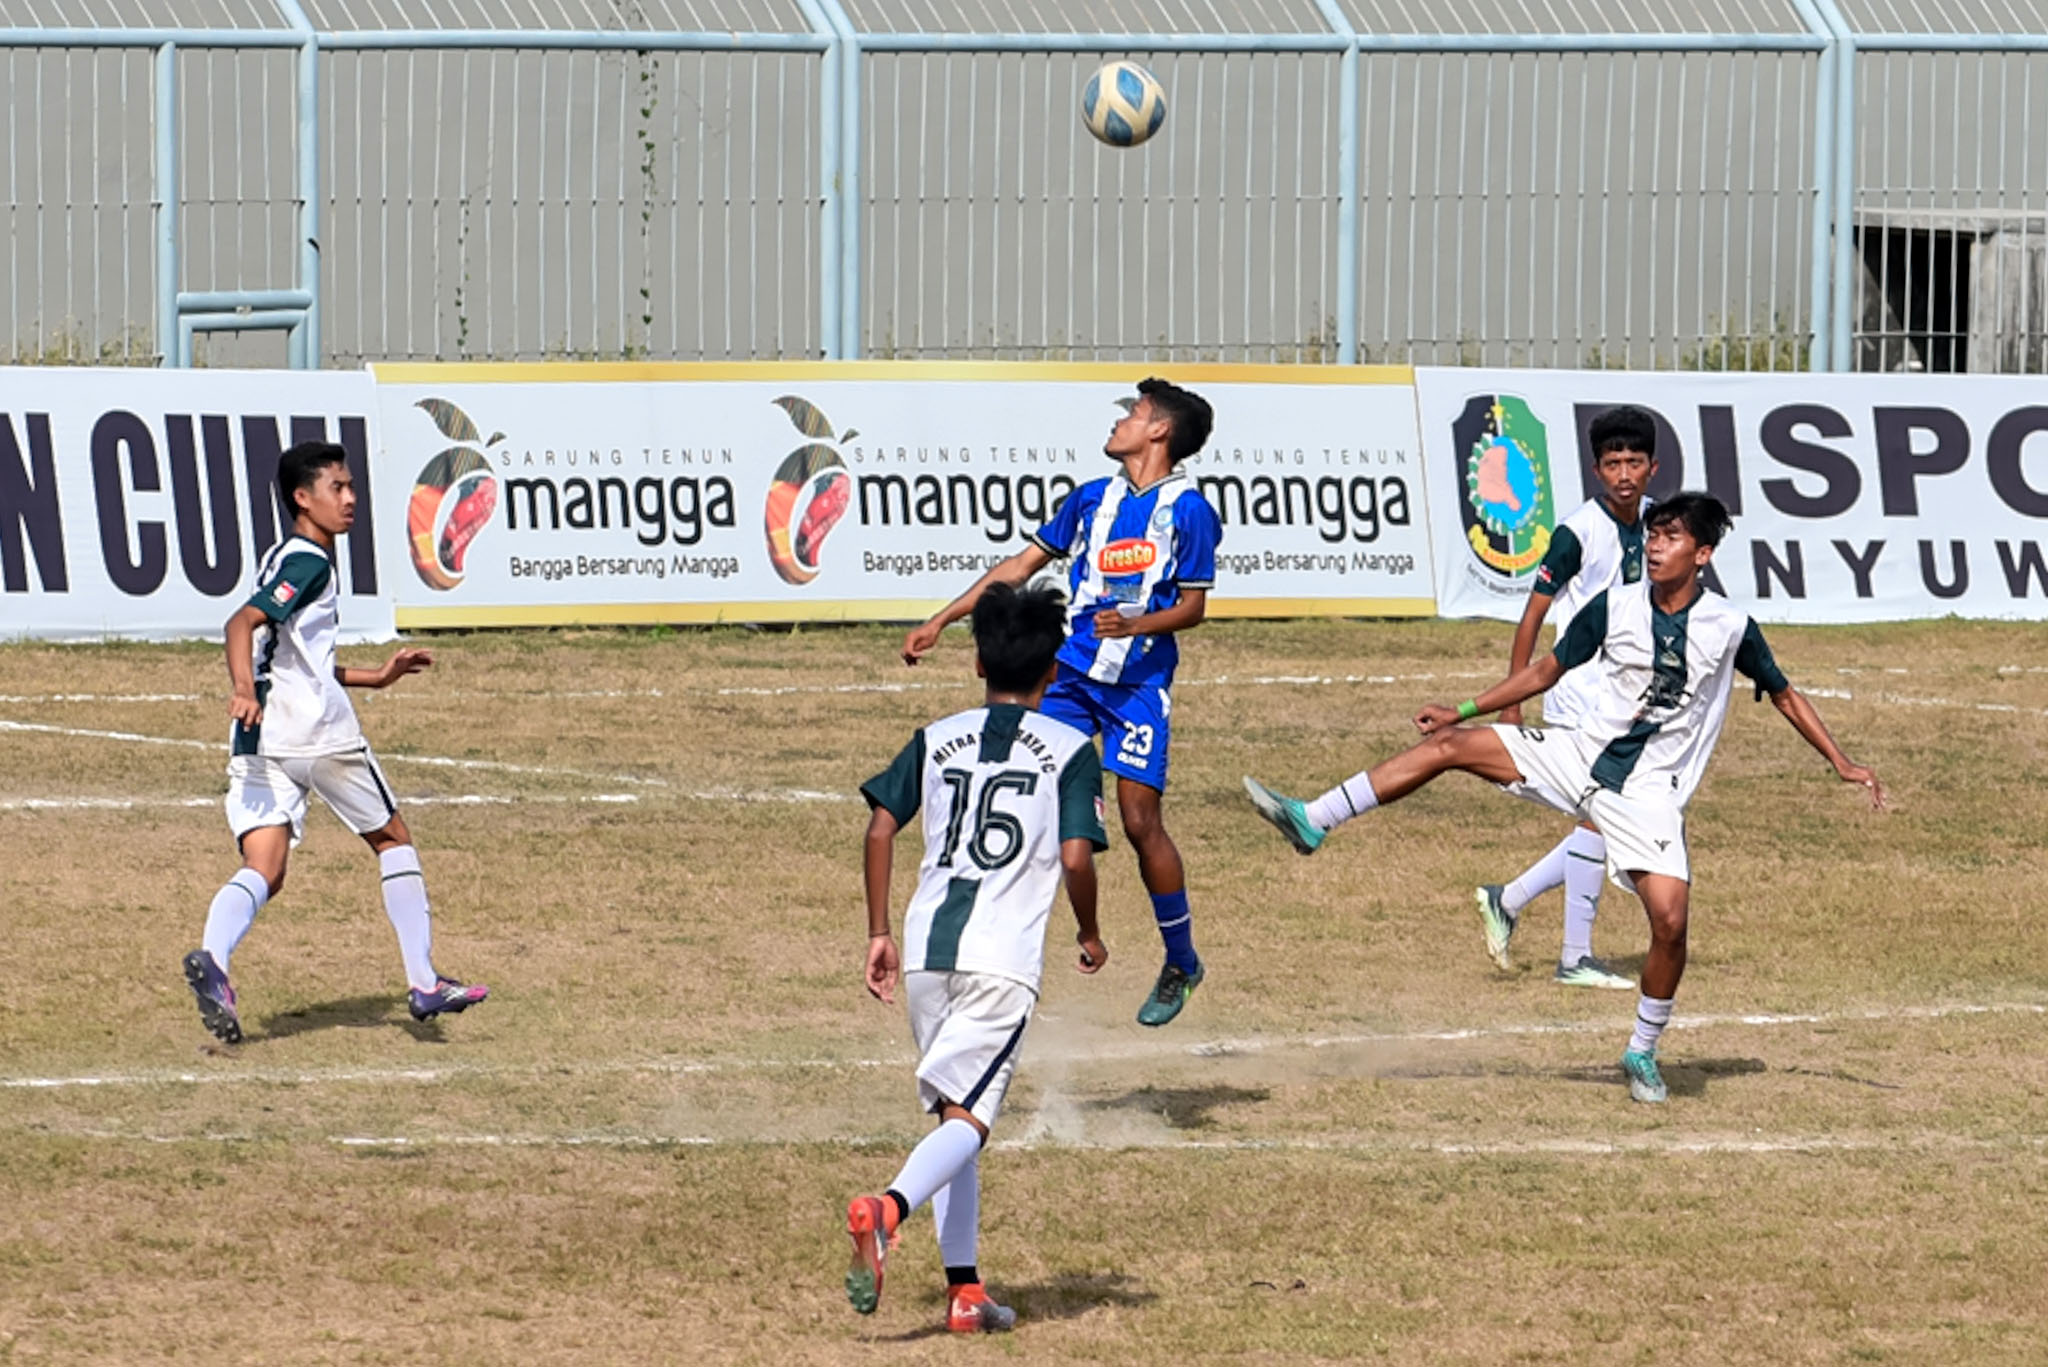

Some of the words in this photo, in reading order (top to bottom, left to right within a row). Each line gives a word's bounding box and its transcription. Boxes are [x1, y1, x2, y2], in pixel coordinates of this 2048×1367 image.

[502, 449, 622, 466] SARUNG
[643, 449, 733, 464] TENUN
[855, 447, 970, 463] SARUNG
[990, 447, 1077, 463] TENUN
[1323, 449, 1407, 465] TENUN
[505, 475, 736, 546] mangga
[858, 474, 1076, 542] mangga
[1197, 475, 1411, 543] mangga
[510, 556, 573, 581] Bangga
[577, 555, 665, 579] Bersarung
[671, 554, 739, 578] Mangga
[864, 551, 924, 576] Bangga
[1215, 553, 1261, 575] angga
[1264, 551, 1346, 574] Bersarung
[1352, 552, 1414, 575] Mangga
[932, 733, 977, 766] MITRA
[1039, 753, 1057, 774] FC
[1122, 720, 1153, 756] 23
[937, 768, 1039, 871] 16
